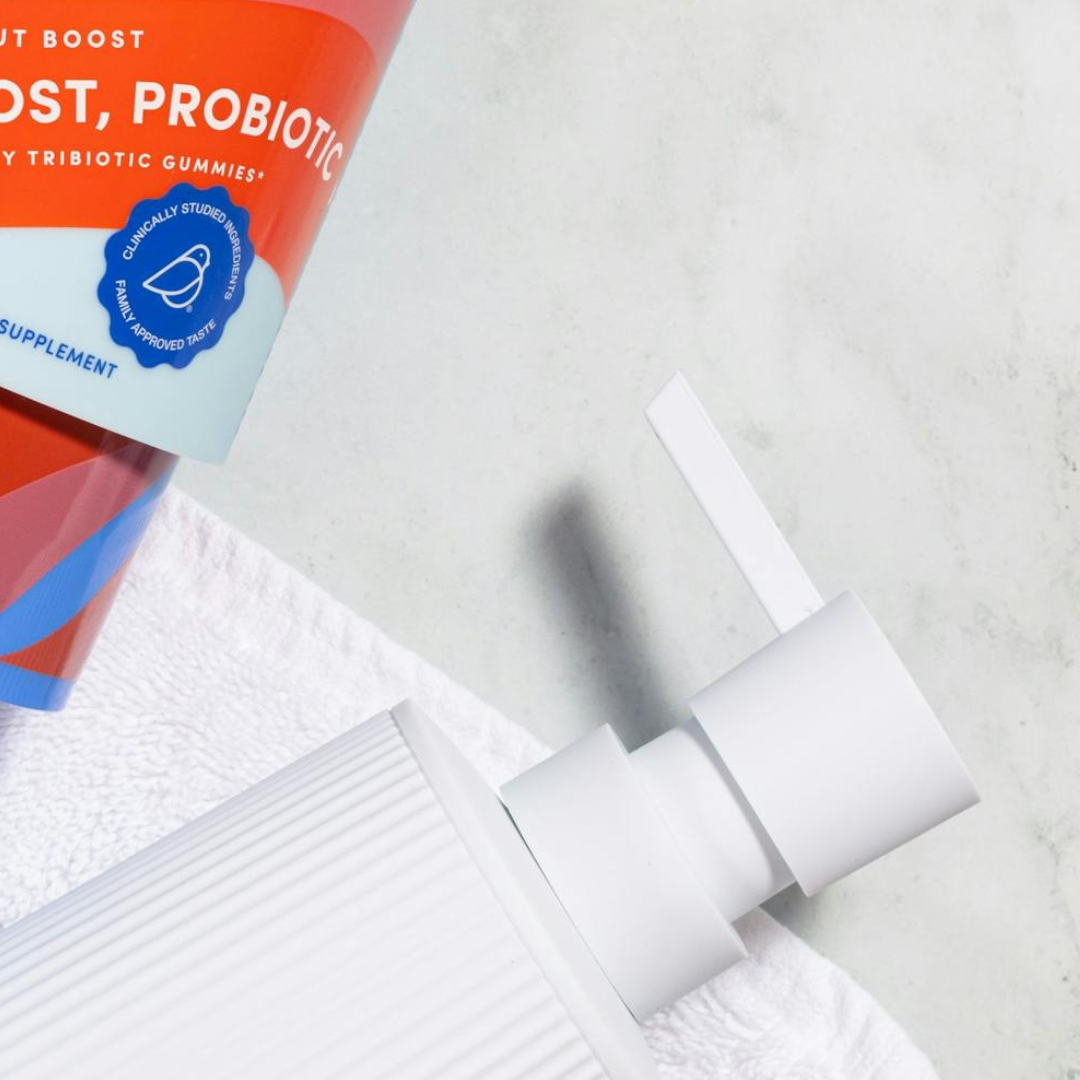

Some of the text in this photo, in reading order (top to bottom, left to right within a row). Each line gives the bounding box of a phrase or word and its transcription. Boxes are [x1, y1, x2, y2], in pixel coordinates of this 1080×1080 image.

[43, 29, 145, 49] BOOST
[27, 149, 152, 169] TRIBIOTIC
[132, 80, 344, 198] PROBIOTIC
[122, 202, 241, 300] CLINICALLY STUDIED INGREDIENTS
[115, 280, 217, 351] FAMILY APPROVED TASTE
